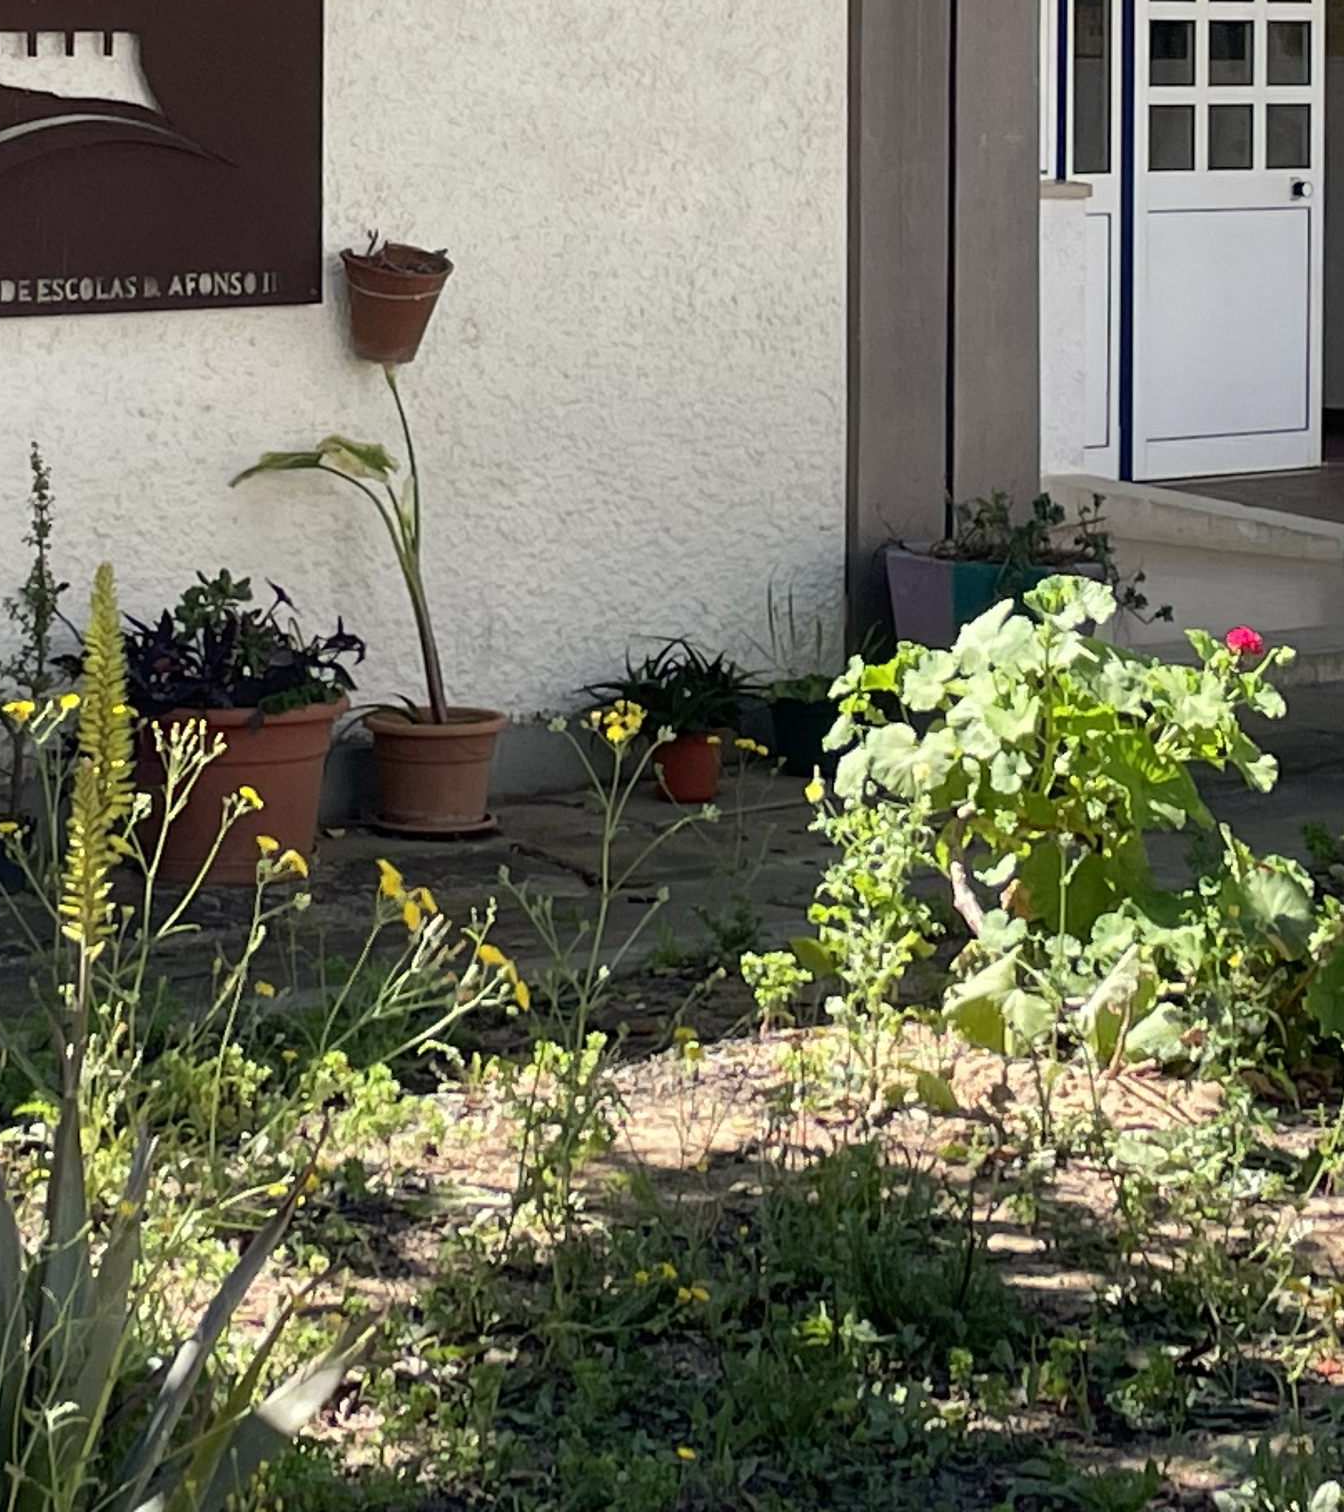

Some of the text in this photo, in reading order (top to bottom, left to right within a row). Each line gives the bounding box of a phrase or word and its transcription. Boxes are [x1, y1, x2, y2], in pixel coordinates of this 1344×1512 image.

[0, 279, 32, 303] DE
[37, 275, 137, 304] ESCOLAS
[168, 271, 257, 298] AFONSO
